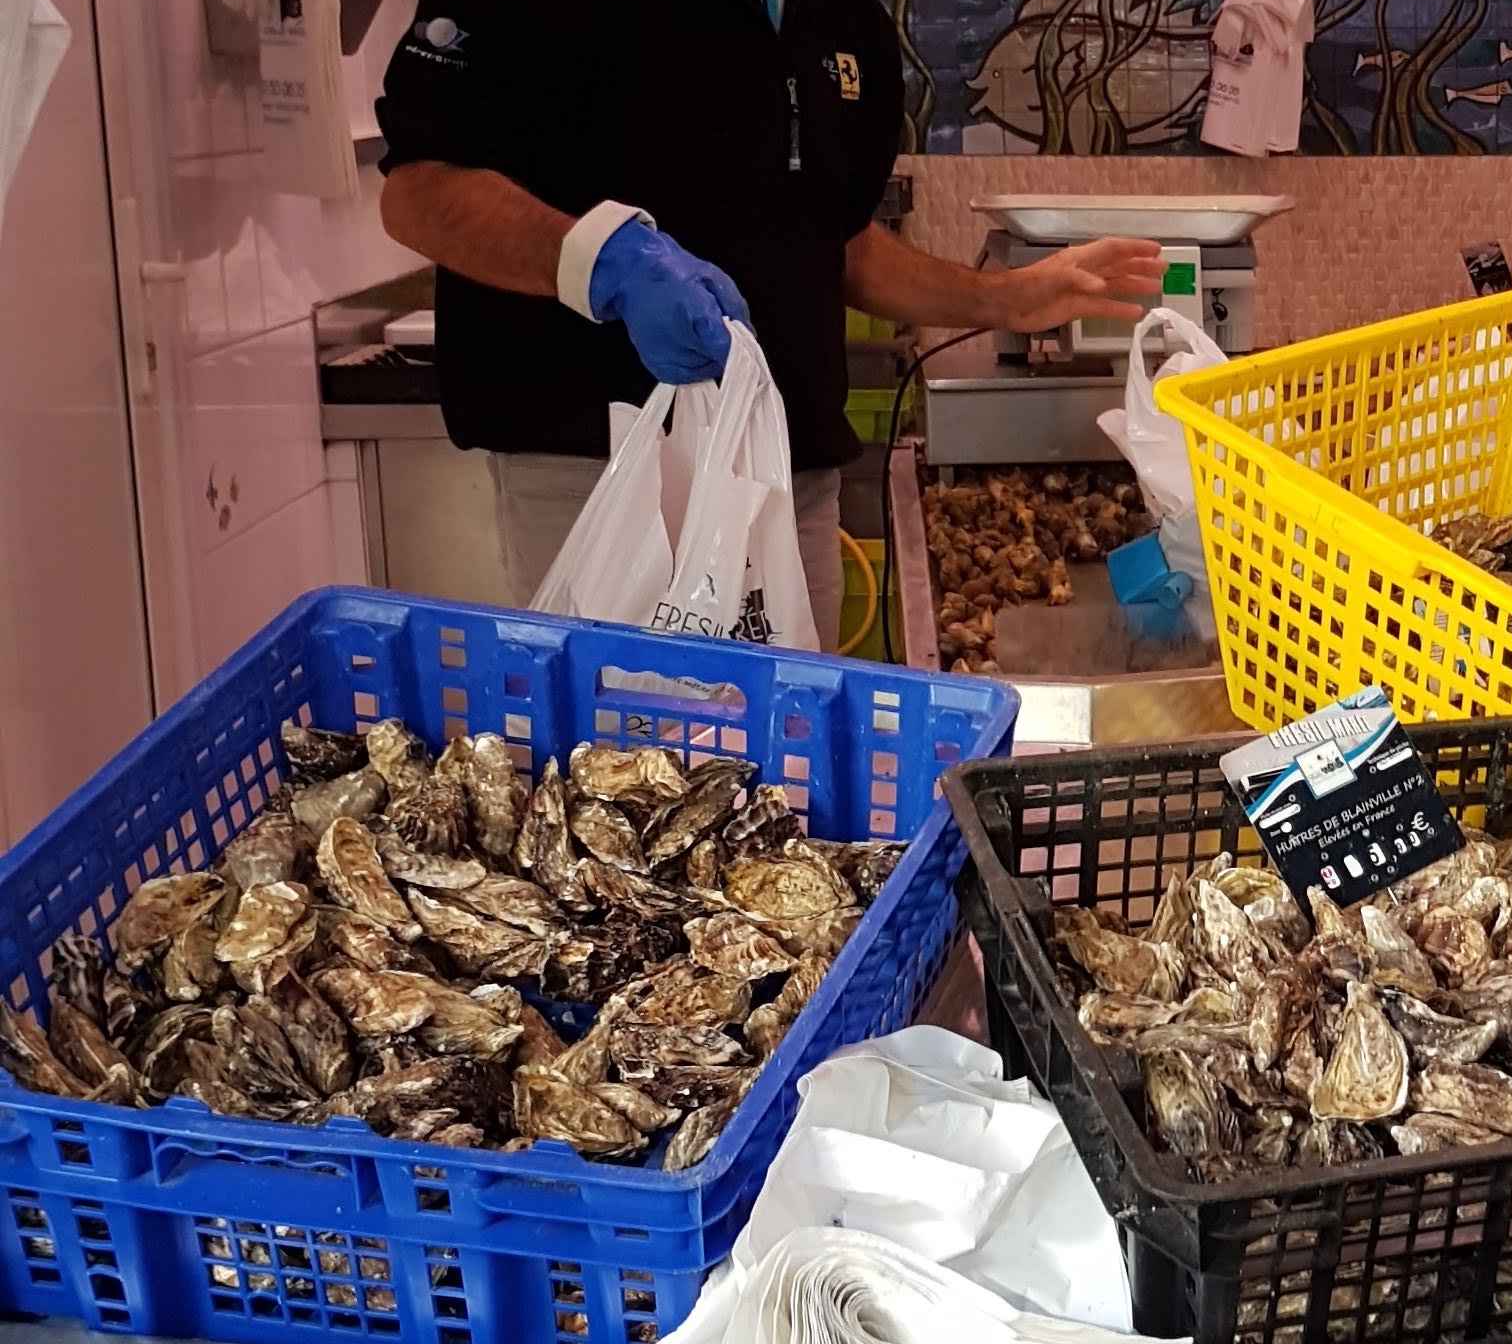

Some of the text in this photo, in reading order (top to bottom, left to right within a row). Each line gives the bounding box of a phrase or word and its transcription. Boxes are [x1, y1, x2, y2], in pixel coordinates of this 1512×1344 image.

[1322, 815, 1340, 830] DE
[1341, 785, 1402, 822] BLAINVILLE
[1352, 821, 1364, 831] en
[1365, 805, 1396, 825] France
